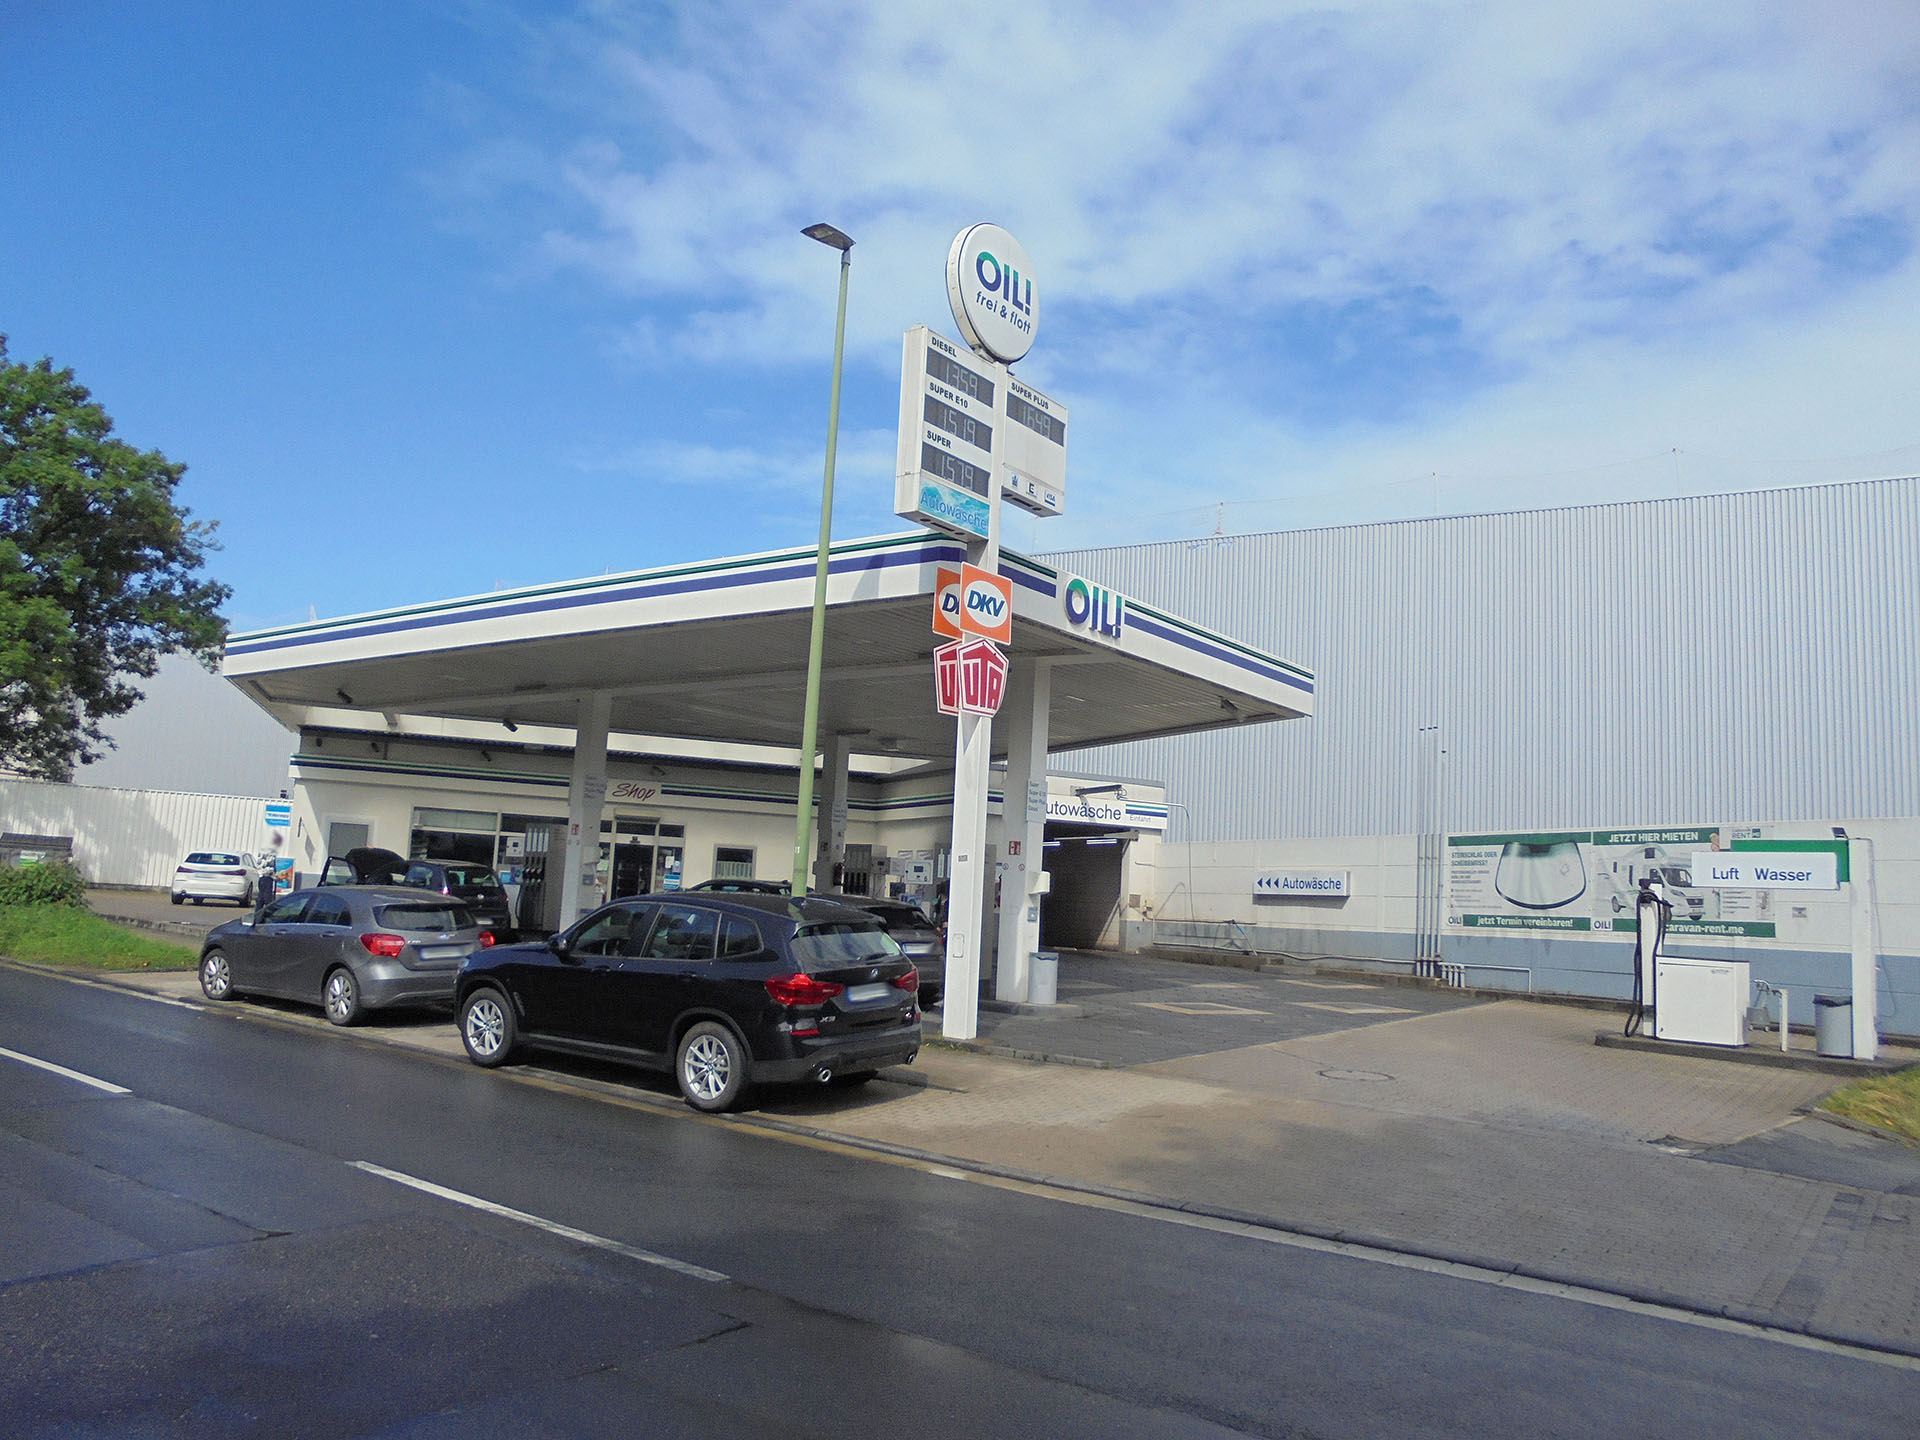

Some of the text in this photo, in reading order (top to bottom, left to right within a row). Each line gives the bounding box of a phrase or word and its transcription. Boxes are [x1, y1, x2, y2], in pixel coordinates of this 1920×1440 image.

[976, 251, 1031, 316] OIL!
[976, 291, 1031, 335] frei & flott
[931, 336, 957, 358] DIESEL
[929, 382, 969, 409] SUPER E10
[1011, 382, 1049, 410] SUPER PLUS
[926, 430, 952, 449] SUPER
[920, 490, 987, 530] Autowäsche
[966, 589, 1006, 618] DKV
[1065, 578, 1123, 639] OIL!
[612, 782, 656, 801] Shop
[1046, 801, 1122, 821] utowäsche
[1608, 831, 1699, 843] JETZT HIER MIETEN
[1282, 877, 1342, 890] Autowäsche
[1711, 867, 1812, 881] Luft Wasser
